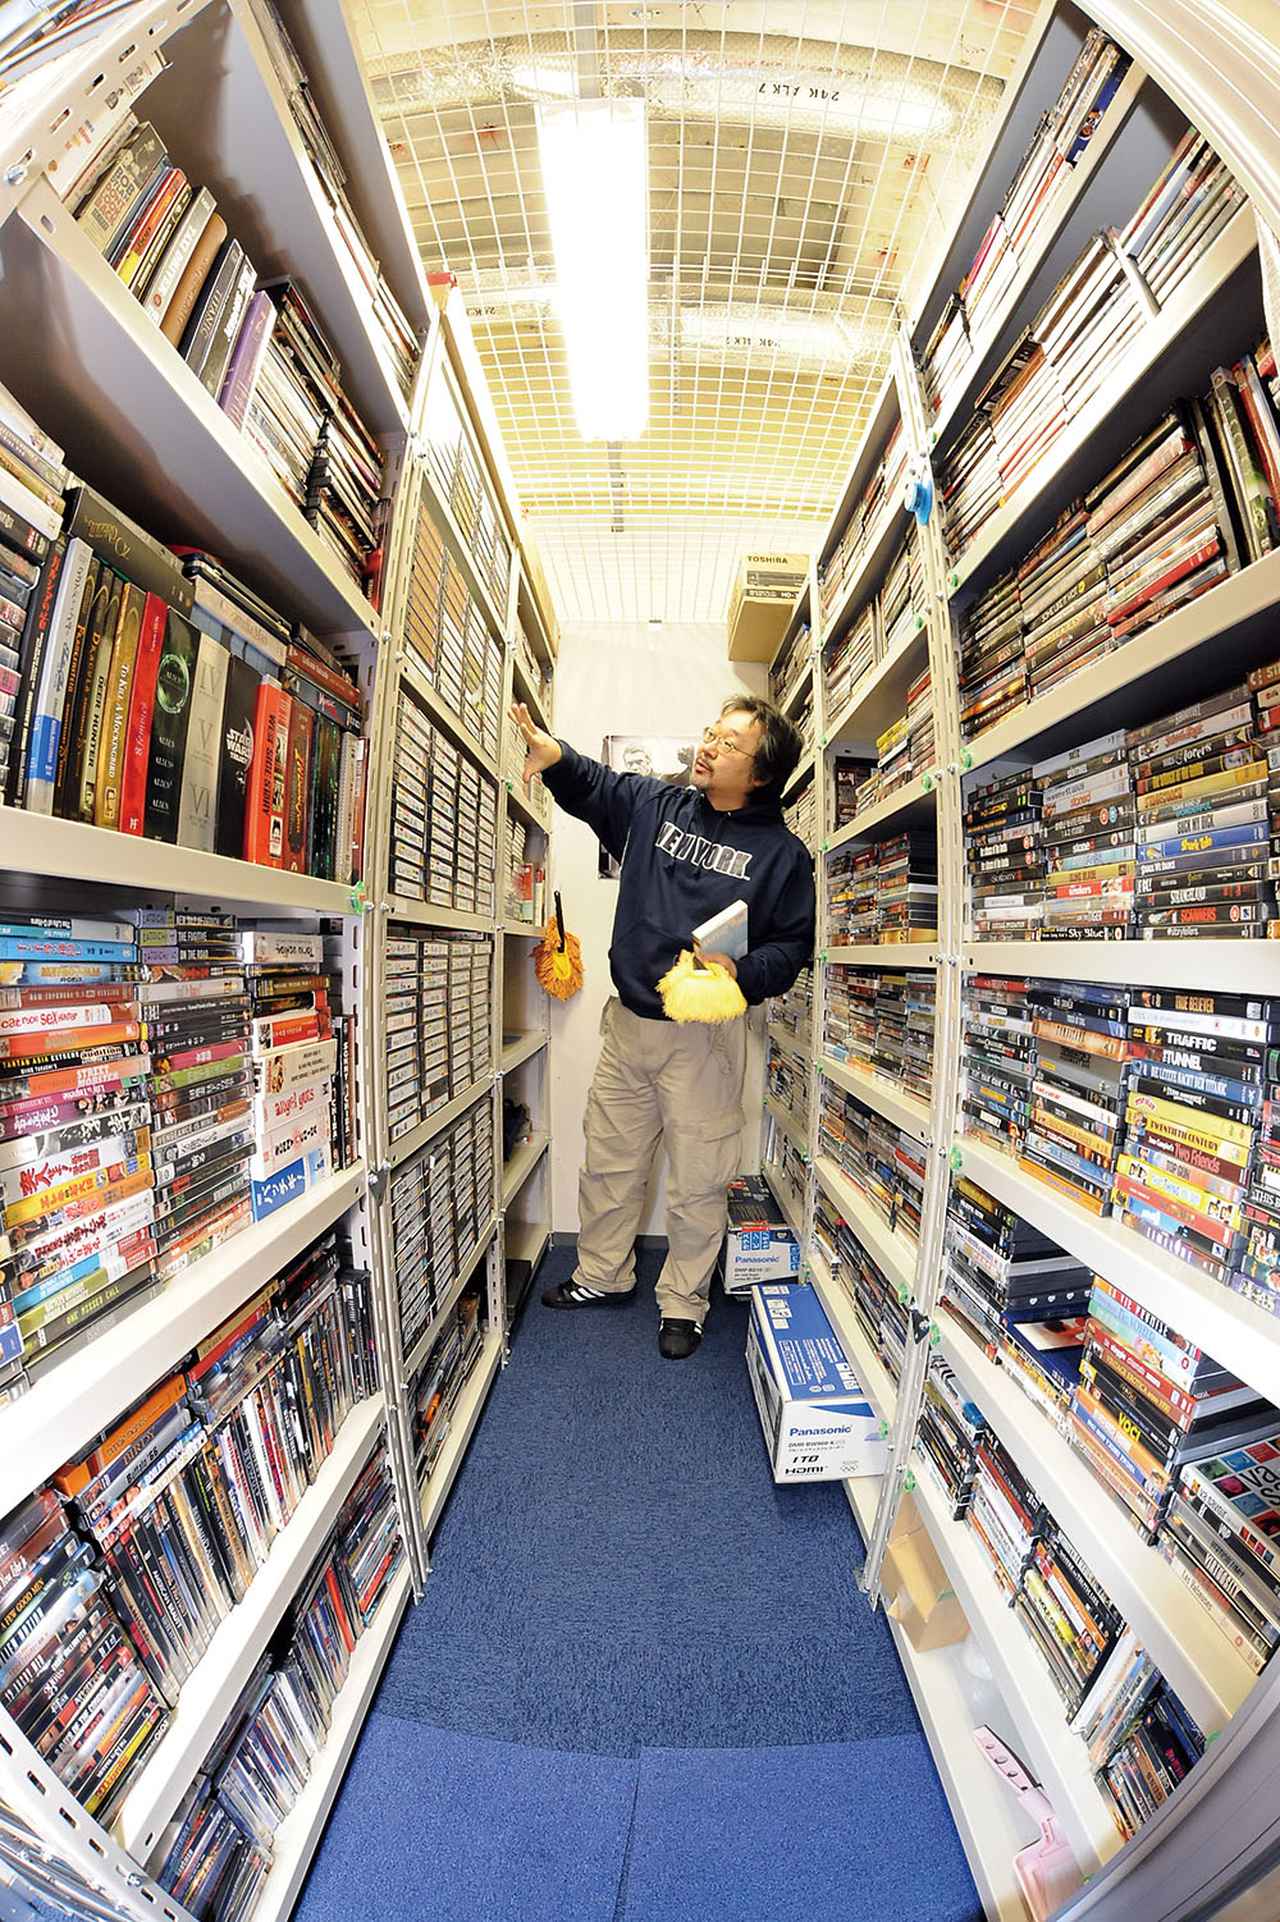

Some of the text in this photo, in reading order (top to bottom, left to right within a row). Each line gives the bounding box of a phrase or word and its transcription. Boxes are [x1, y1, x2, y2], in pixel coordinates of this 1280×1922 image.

[202, 289, 222, 338] TITANIC
[747, 556, 788, 564] TOSHIBA
[201, 662, 220, 690] IV
[88, 675, 105, 768] DEER HUNTER
[199, 718, 213, 748] V
[108, 713, 122, 778] MOCKINGBIRD
[226, 728, 250, 748] STAR
[226, 739, 252, 759] WARS
[190, 783, 211, 818] VI
[691, 836, 752, 880] YORK
[1180, 907, 1217, 922] SCANNERS
[178, 930, 187, 941] THE
[1068, 927, 1104, 940] Sky Blue
[1189, 996, 1214, 1014] BELIEVER
[1166, 1032, 1217, 1052] TRAFFIC
[3, 1057, 31, 1069] TARTAN
[32, 1055, 49, 1065] ASIA
[1166, 1051, 1202, 1071] TUNNEL
[1150, 1117, 1218, 1150] TWENTIETH CENTURY
[1174, 1142, 1190, 1163] Two
[1190, 1148, 1221, 1174] Friends
[1254, 1188, 1274, 1206] THIS
[66, 1311, 78, 1325] ONE
[104, 1286, 120, 1301] CALL
[789, 1425, 851, 1437] Panasonic
[1118, 1412, 1141, 1442] VOCI
[785, 1467, 824, 1475] HDMI
[1204, 1551, 1240, 1599] VIRTUOSITY
[4, 1611, 18, 1629] FEW
[15, 1590, 34, 1613] GOOD
[31, 1579, 46, 1597] MEN
[150, 1569, 184, 1628] AMERICAN BEAUTY
